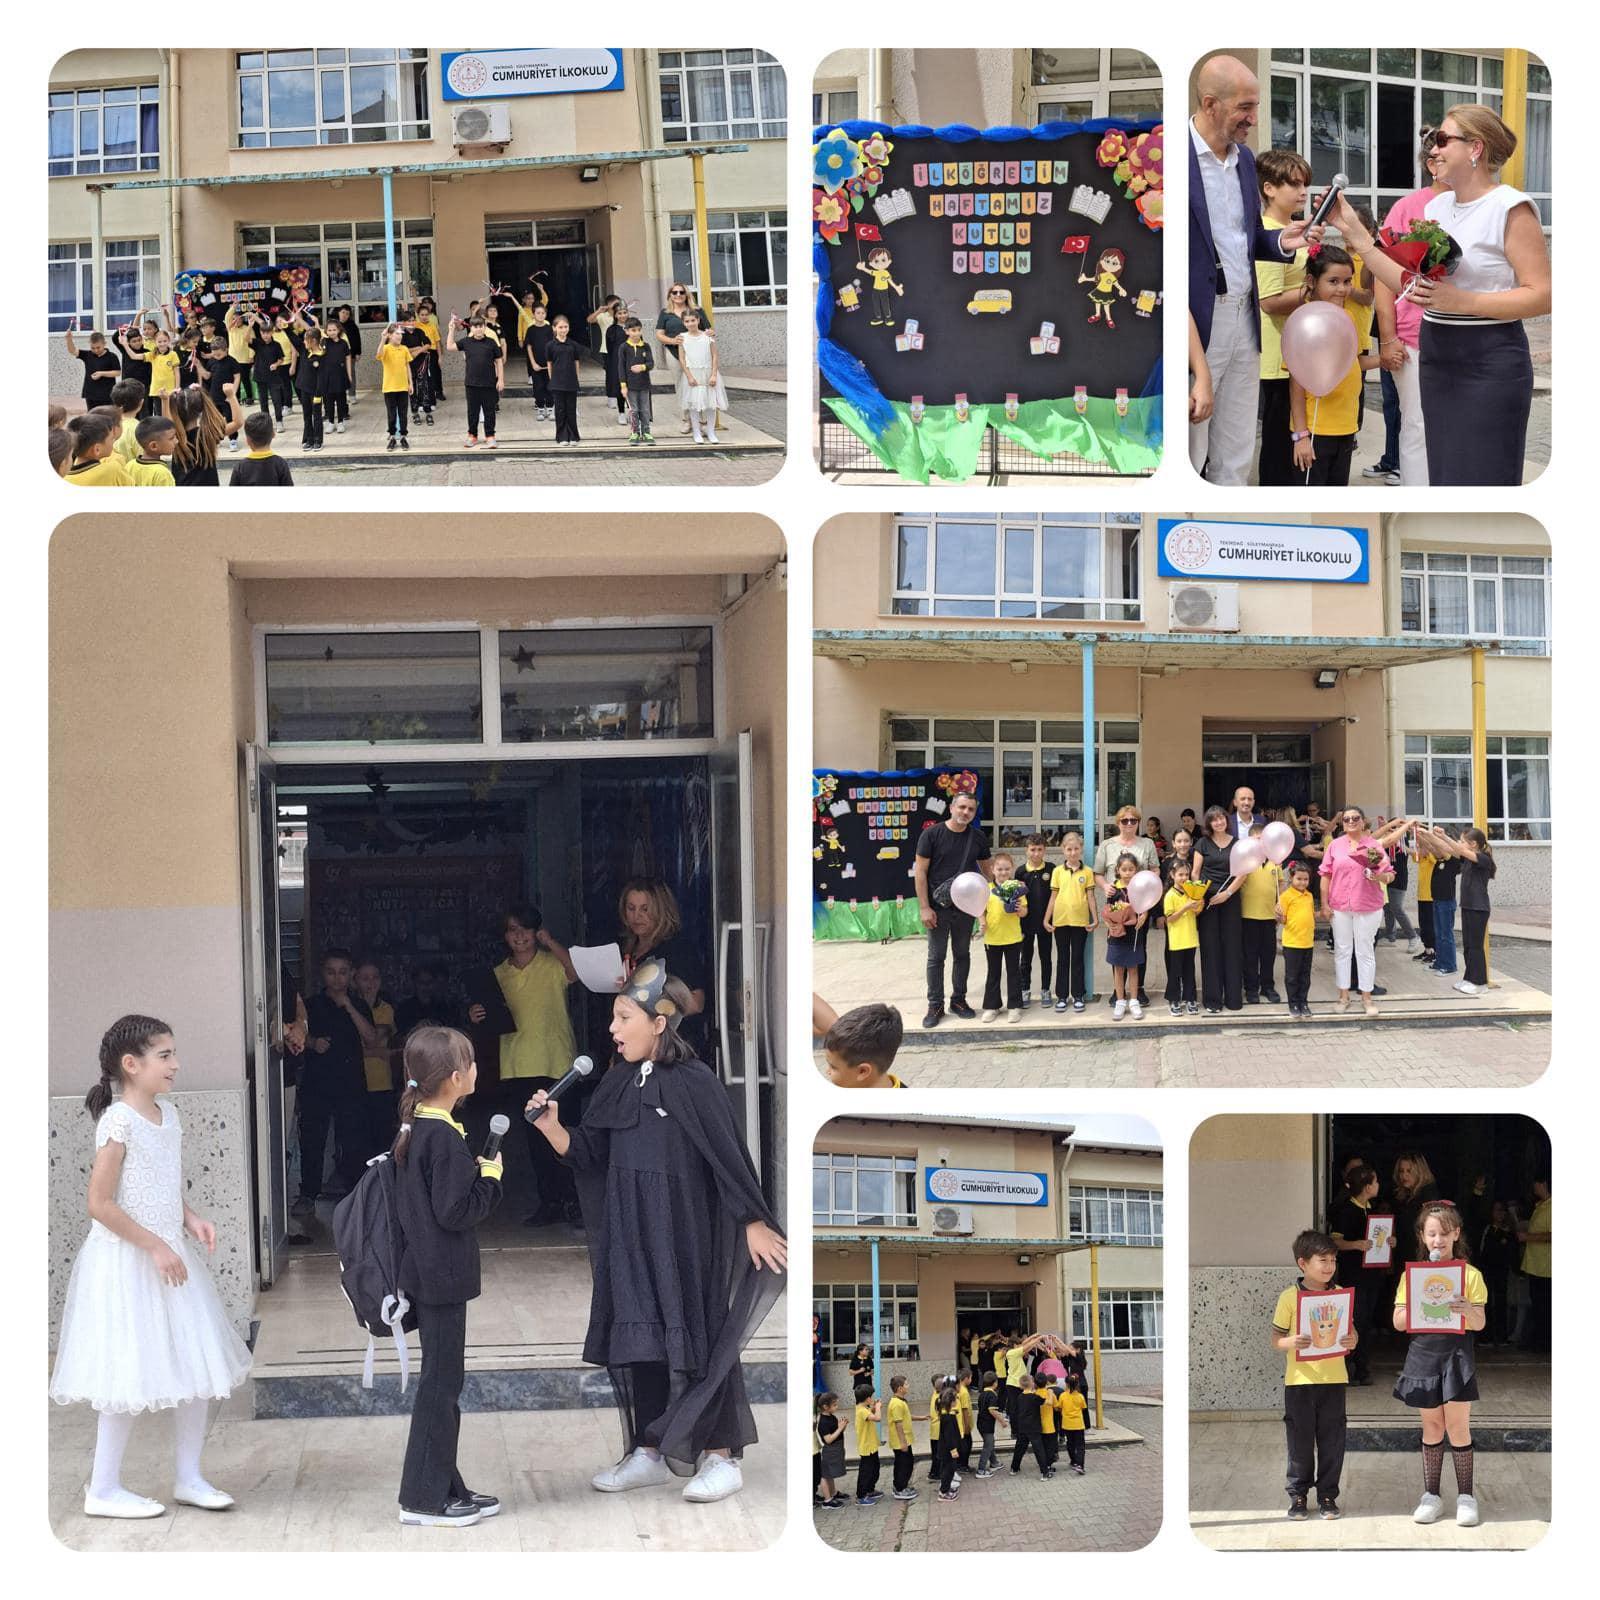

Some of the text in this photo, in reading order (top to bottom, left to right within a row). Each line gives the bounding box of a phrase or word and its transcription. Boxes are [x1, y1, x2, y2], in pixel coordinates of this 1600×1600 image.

[492, 65, 609, 82] CUMHURİYET İLKOKULU
[917, 162, 1067, 183] İLKÖĞRETİM
[932, 196, 1050, 213] HAFTAMIZ
[954, 226, 1029, 242] KUTLU
[955, 255, 1029, 271] OLSUN
[1218, 547, 1352, 564] CUMHURİYET İLKOKULU
[869, 816, 908, 826] KUTLU
[870, 829, 908, 839] OLSUN
[961, 1183, 1039, 1195] CUMHURİYET İLKOKULU
